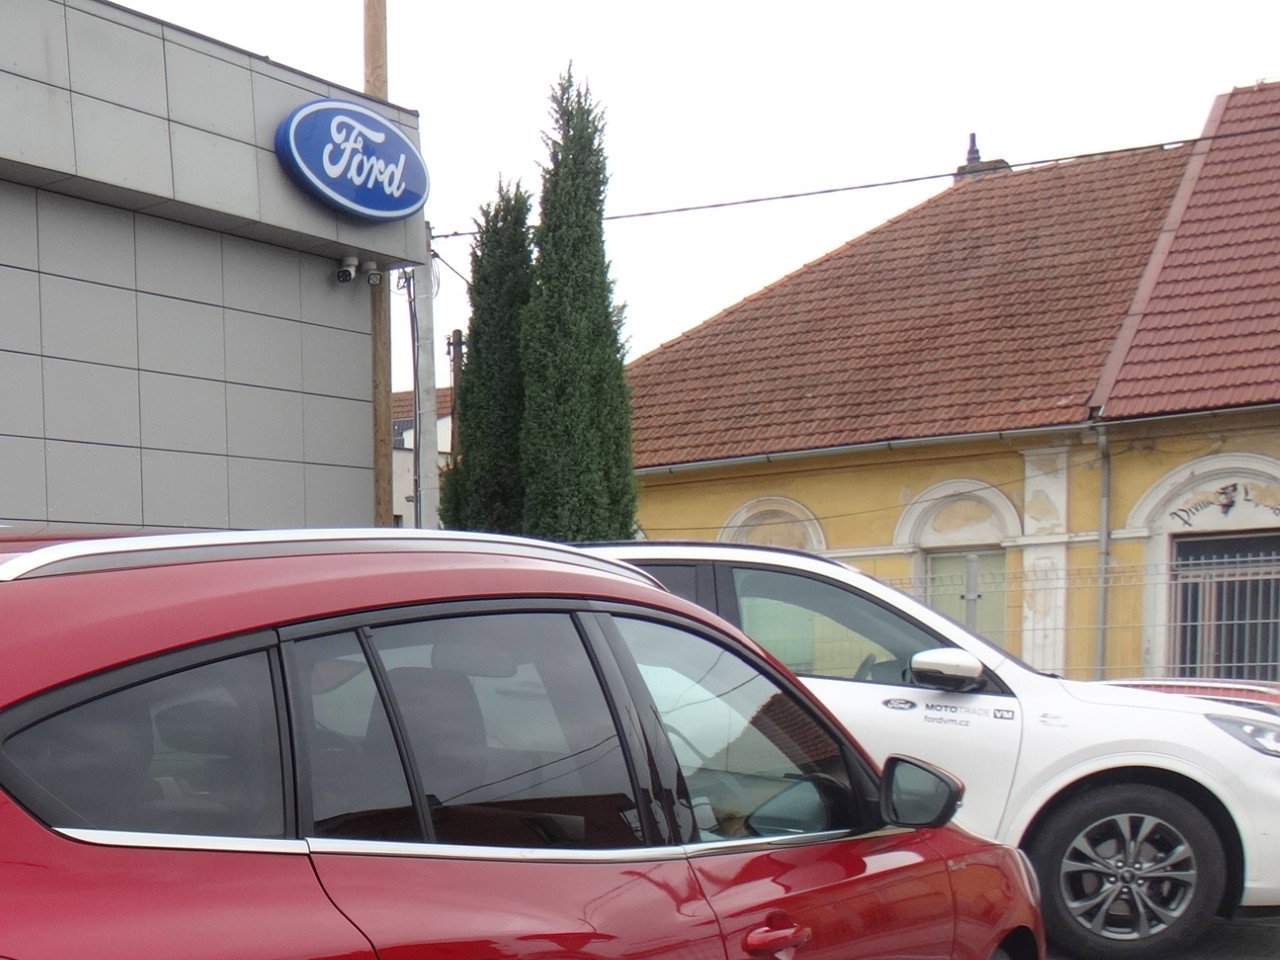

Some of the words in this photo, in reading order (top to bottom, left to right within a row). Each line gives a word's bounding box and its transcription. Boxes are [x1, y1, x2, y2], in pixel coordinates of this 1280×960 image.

[322, 115, 406, 198] Ford
[995, 710, 1013, 719] VM
[923, 715, 970, 726] fordvm.cz
